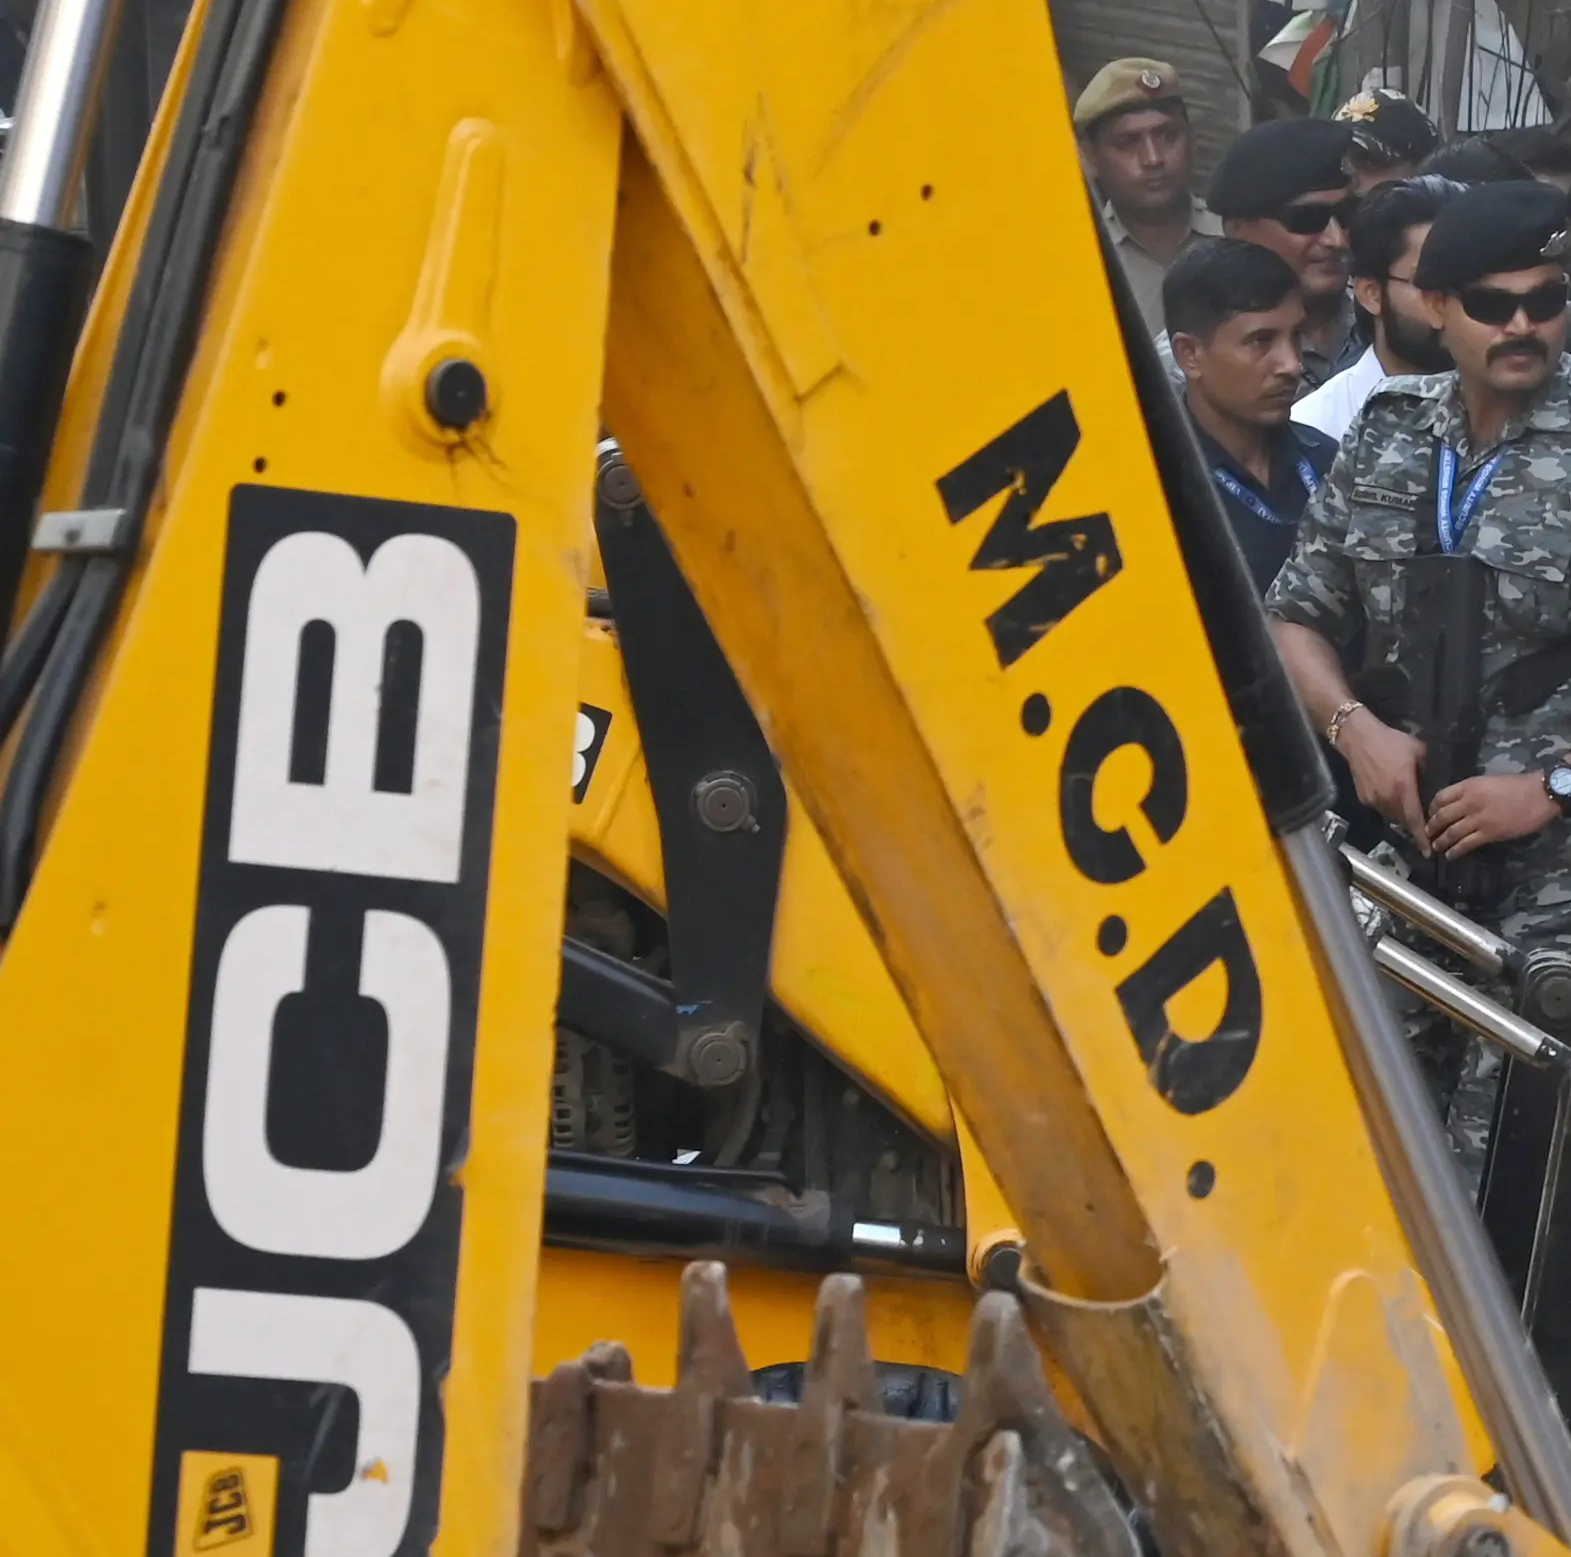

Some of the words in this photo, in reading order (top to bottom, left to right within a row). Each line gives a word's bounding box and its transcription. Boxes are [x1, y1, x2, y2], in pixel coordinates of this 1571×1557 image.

[187, 529, 483, 1557] JCB
[936, 389, 1263, 1200] M.C.D.
[204, 1474, 246, 1535] JCB
